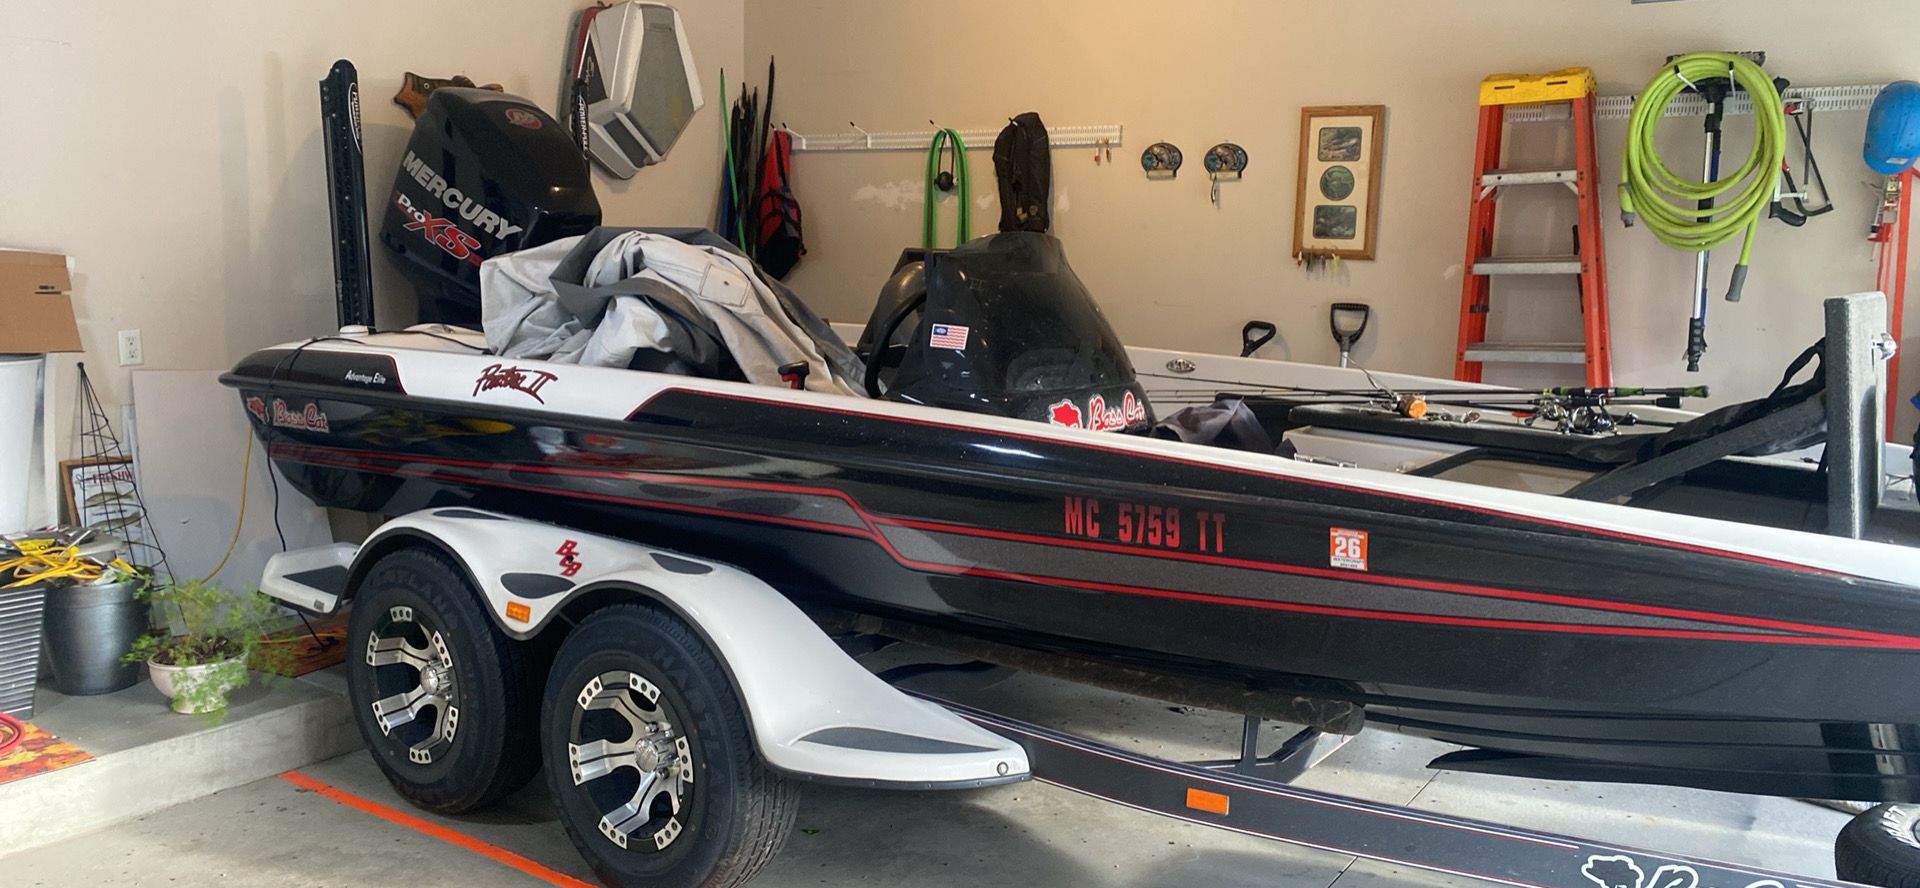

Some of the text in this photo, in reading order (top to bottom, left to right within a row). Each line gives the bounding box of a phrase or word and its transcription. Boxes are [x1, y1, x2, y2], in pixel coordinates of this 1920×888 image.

[398, 194, 426, 223] Pro
[403, 150, 523, 240] MERCURY
[345, 370, 386, 384] Advantage Elite
[274, 399, 329, 432] Bass Cat
[1087, 395, 1125, 431] Bass
[1065, 496, 1225, 553] MC 5759 TT
[1335, 536, 1360, 558] 26
